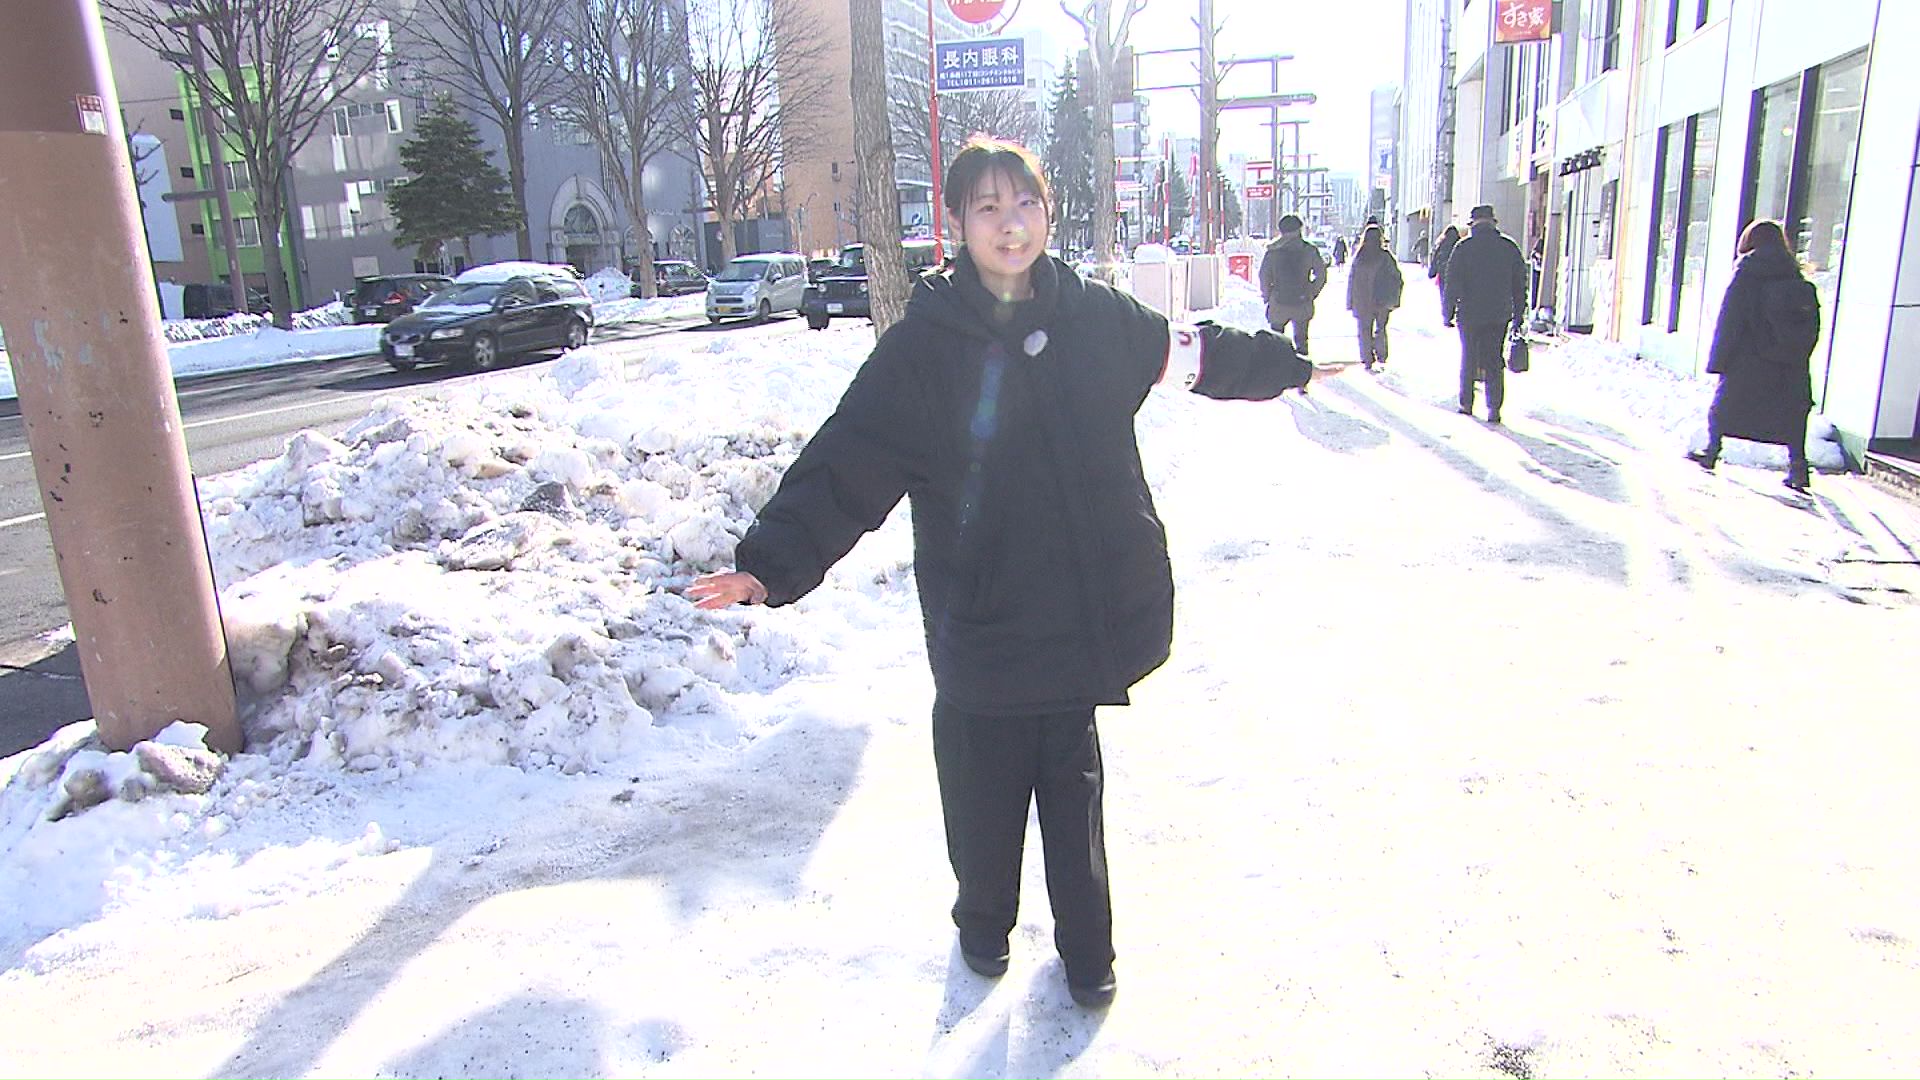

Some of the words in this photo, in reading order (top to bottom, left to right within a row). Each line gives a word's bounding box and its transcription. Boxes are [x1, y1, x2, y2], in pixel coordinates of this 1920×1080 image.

[1501, 2, 1545, 29] すき家
[943, 46, 1019, 68] 長内眼科
